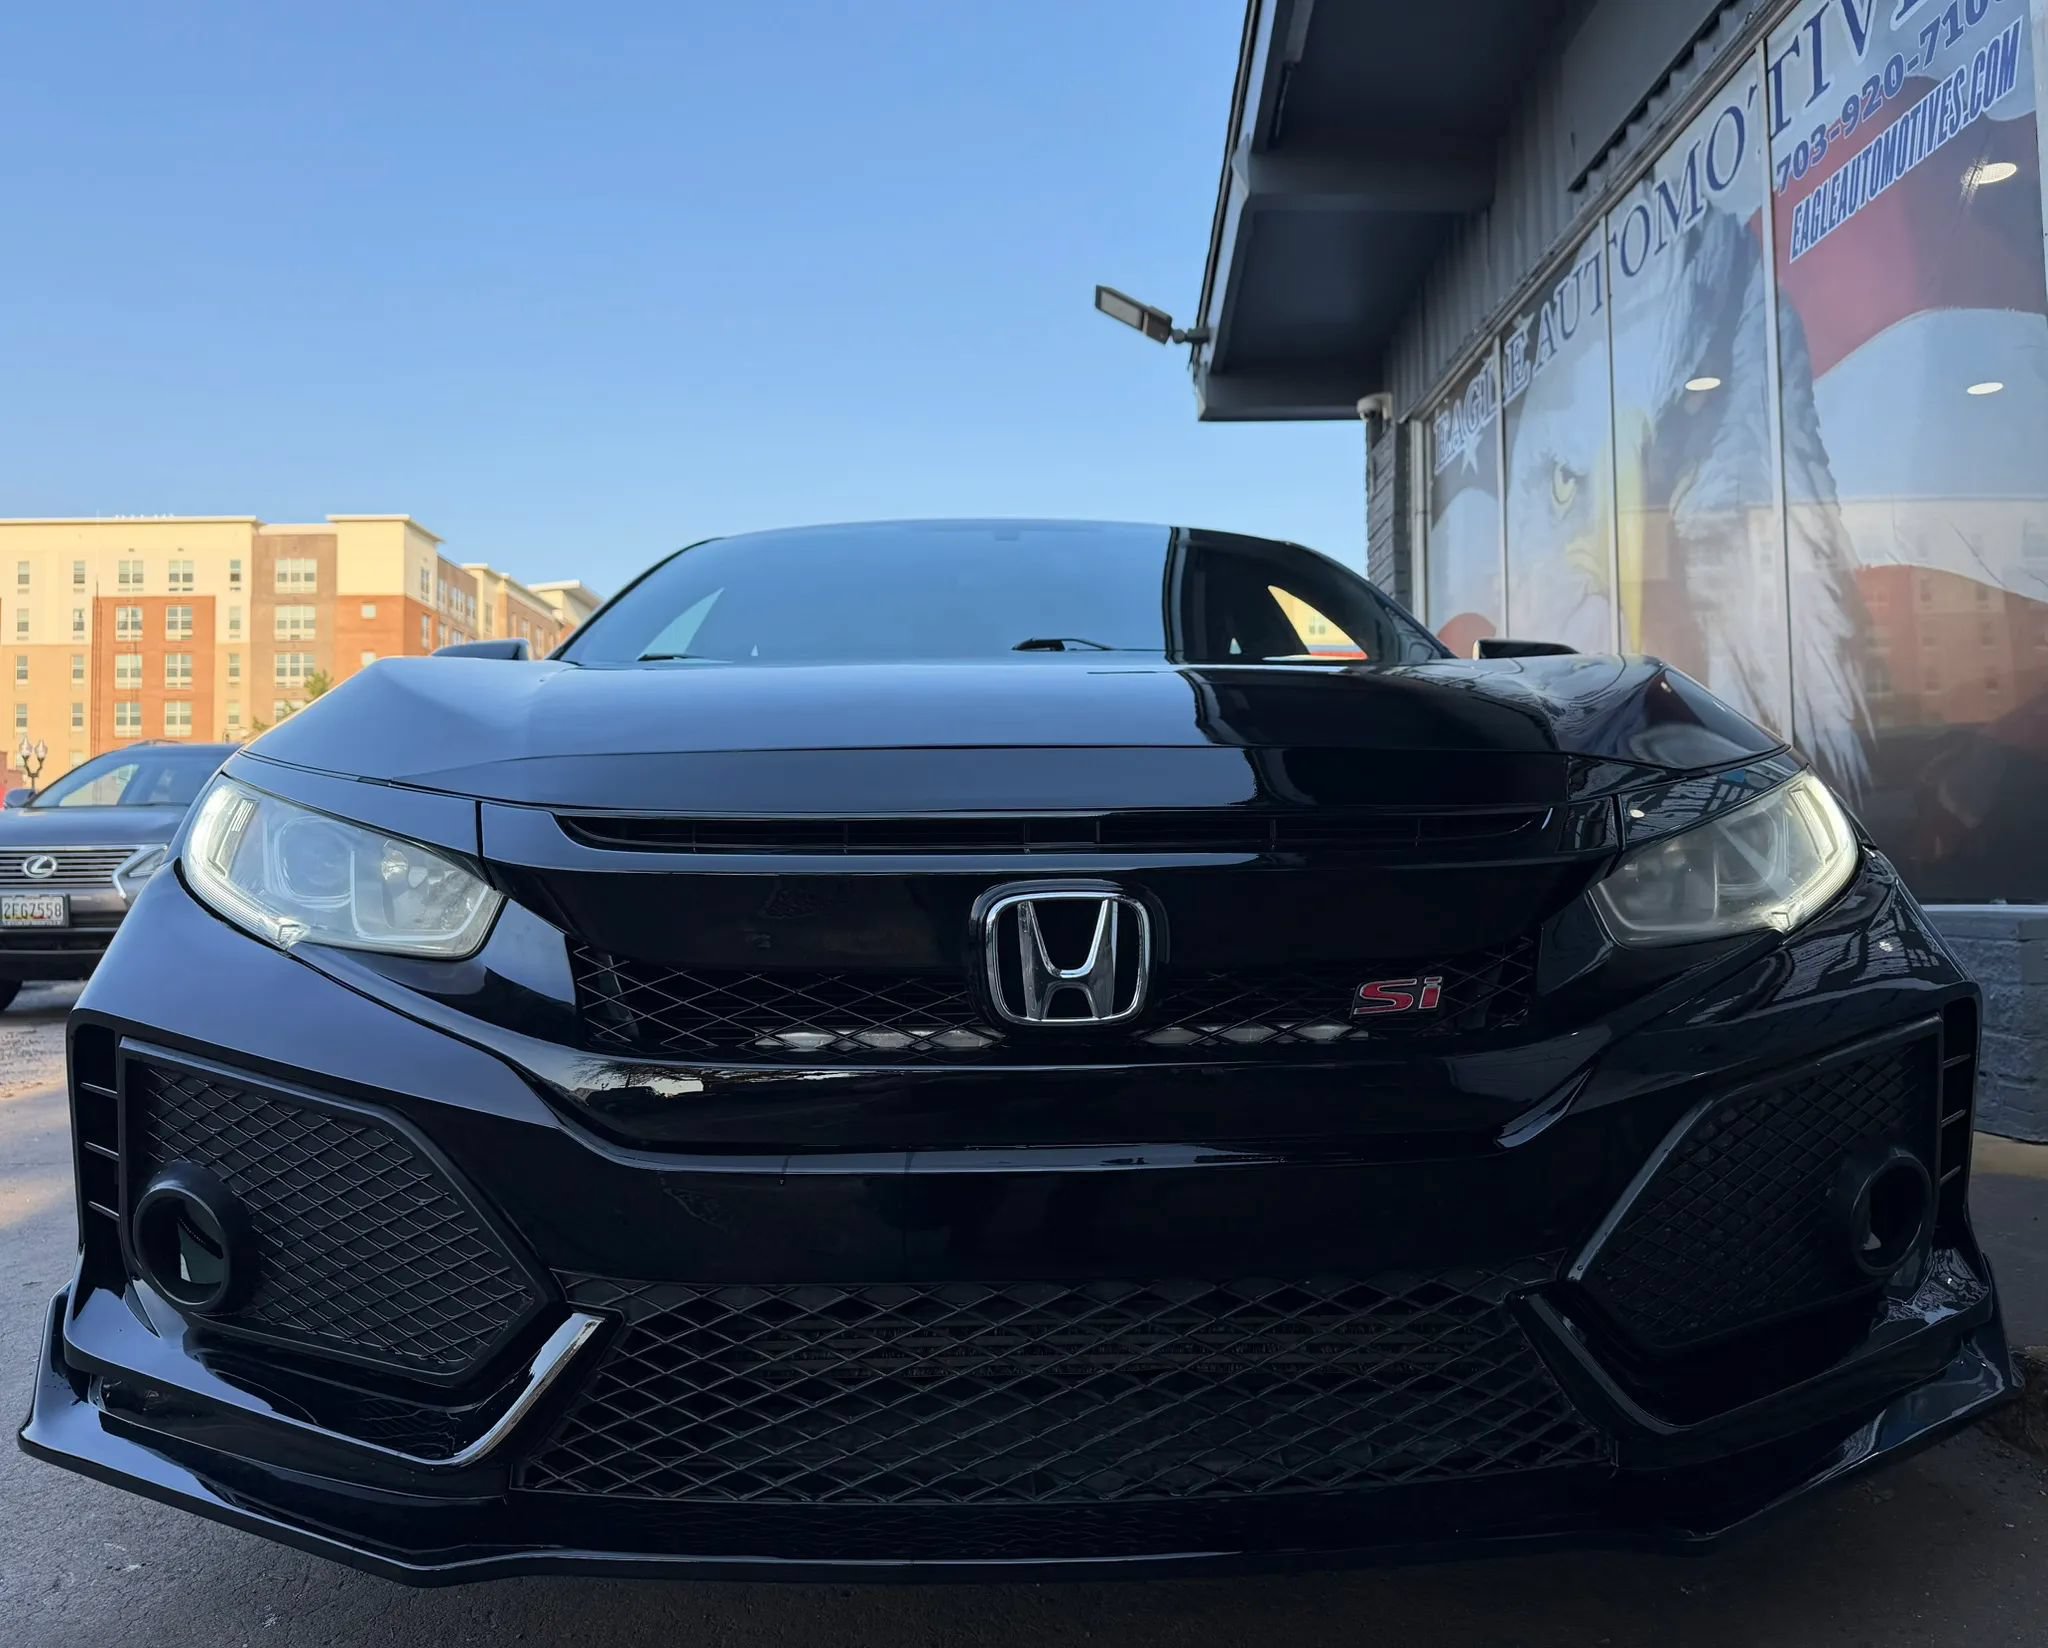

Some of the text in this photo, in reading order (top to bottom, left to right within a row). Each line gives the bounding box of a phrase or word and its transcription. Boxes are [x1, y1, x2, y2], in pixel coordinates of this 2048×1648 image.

[1777, 0, 2003, 195] 703-920-710
[1789, 16, 2023, 264] EAGLEAUTOMOTIVES.COM
[1434, 0, 1924, 476] EAGLE AUTOMOTIV
[1353, 976, 1443, 1015] Si
